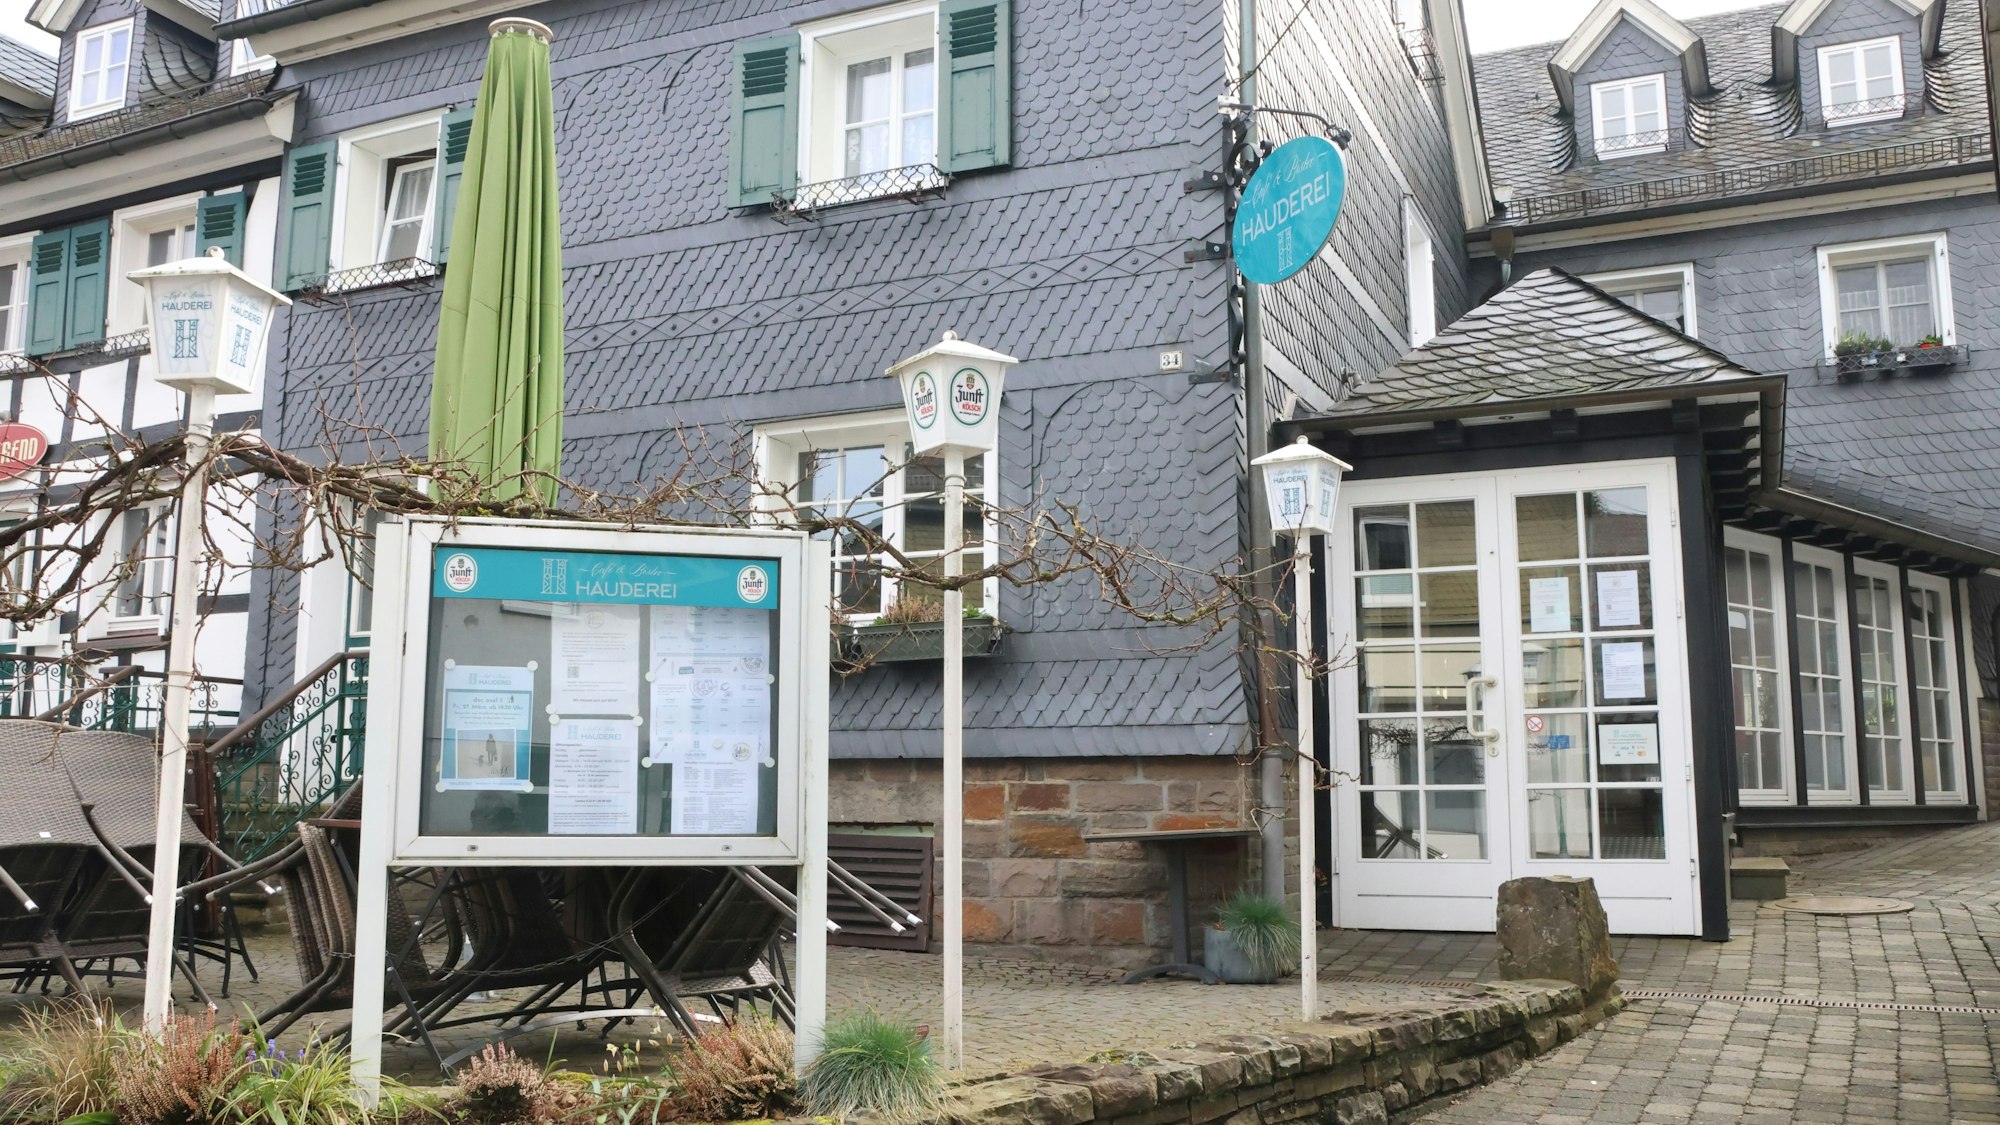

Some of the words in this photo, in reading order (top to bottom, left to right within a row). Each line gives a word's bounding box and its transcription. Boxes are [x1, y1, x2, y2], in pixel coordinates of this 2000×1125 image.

[1242, 171, 1331, 246] HAUDEREI
[162, 301, 212, 311] HAUDEREI
[230, 303, 263, 326] HAUDEREI
[955, 384, 984, 404] Zunft
[962, 402, 982, 412] KÖLSCH
[0, 437, 38, 464] REND
[1273, 475, 1308, 484] HAUDEREI
[449, 566, 472, 578] Zunft
[576, 580, 677, 598] HAUDEREI
[742, 577, 764, 590] Zunft
